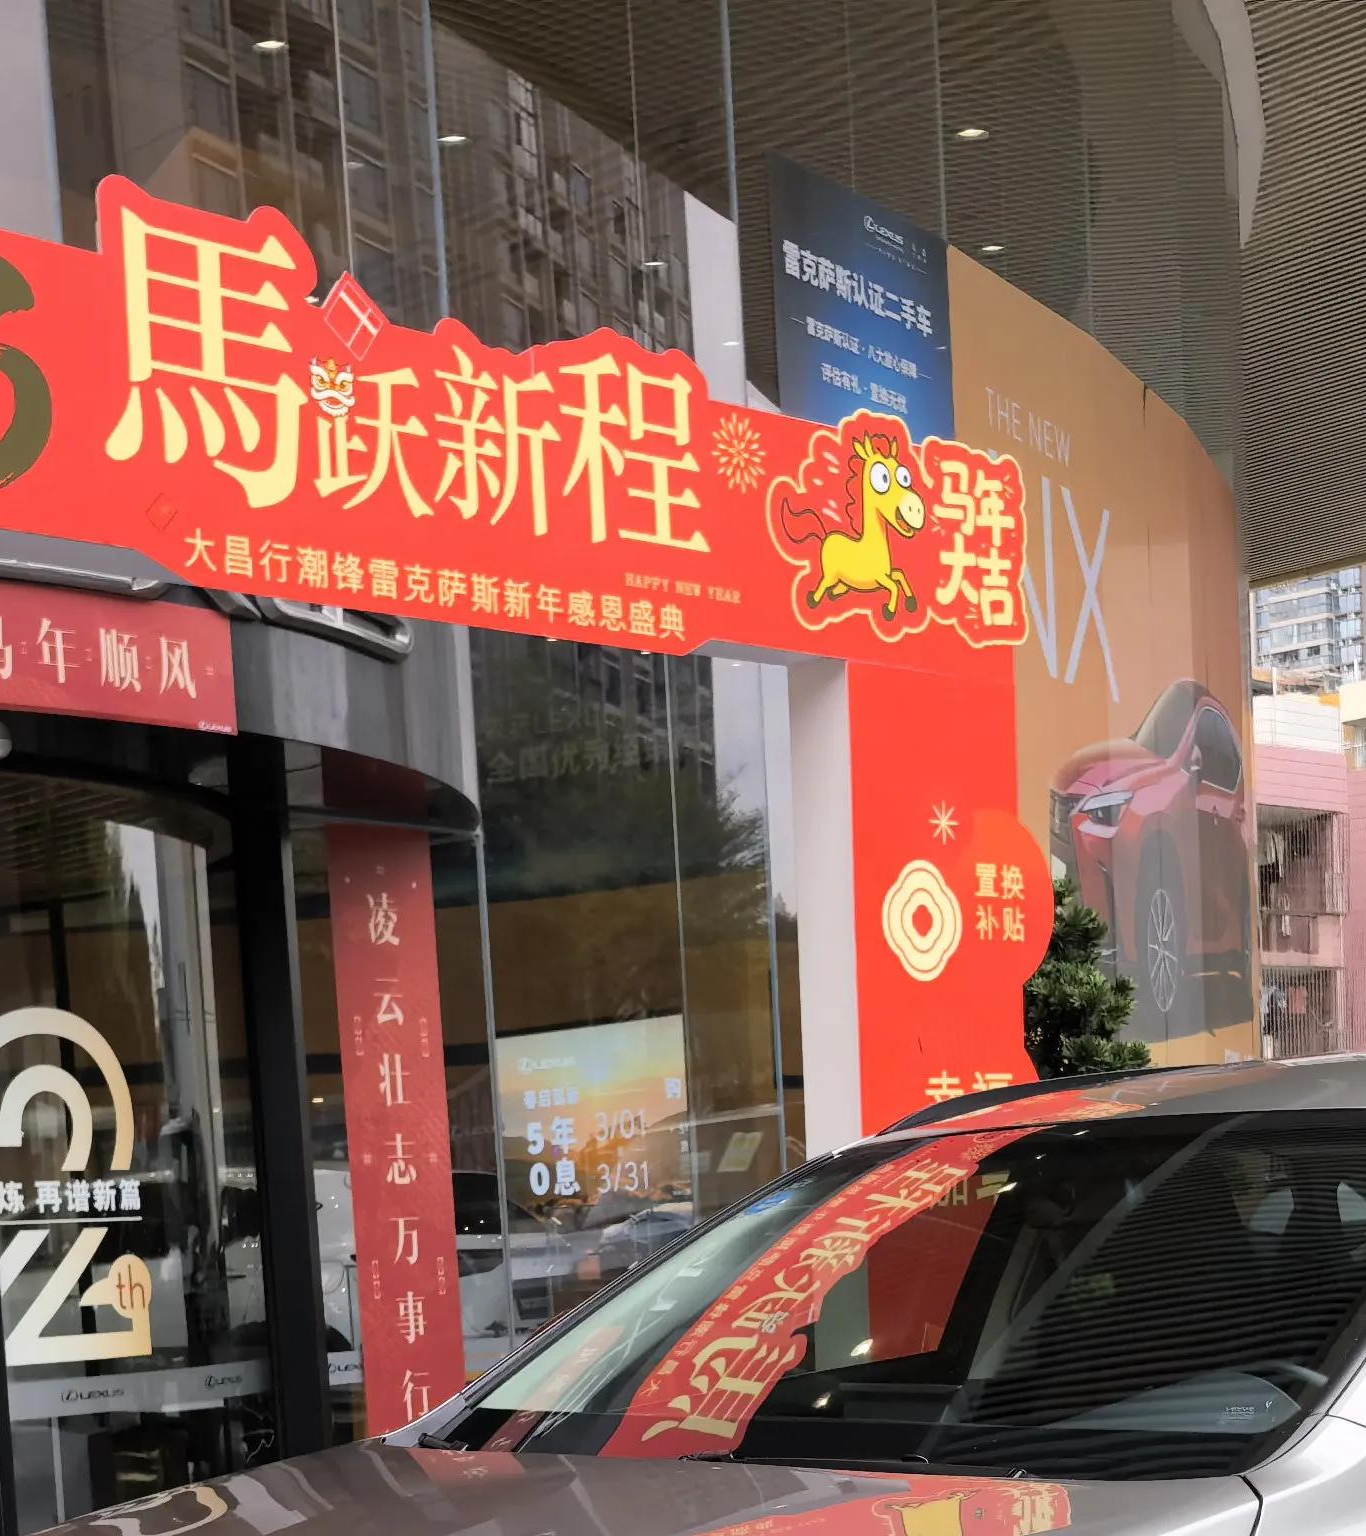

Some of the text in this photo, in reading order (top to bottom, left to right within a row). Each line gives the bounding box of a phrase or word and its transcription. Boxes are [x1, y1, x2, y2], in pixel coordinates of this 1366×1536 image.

[782, 238, 933, 338] 雷克萨斯认证二手车
[985, 386, 1071, 468] THE NEW
[933, 461, 1015, 548] 马年
[184, 527, 687, 641] 大昌行潮锋雷克萨斯新年感恩盛典
[624, 573, 741, 604] HAPPY NEW YEAR
[936, 538, 1014, 627] 大吉
[974, 863, 1025, 901] 置换
[975, 906, 1026, 943] 补贴
[526, 1116, 576, 1155] 5年
[594, 1108, 648, 1143] 3/01
[529, 1157, 581, 1196] 0息
[596, 1160, 650, 1194] 3/31
[35, 1179, 142, 1214] 再谱新篇
